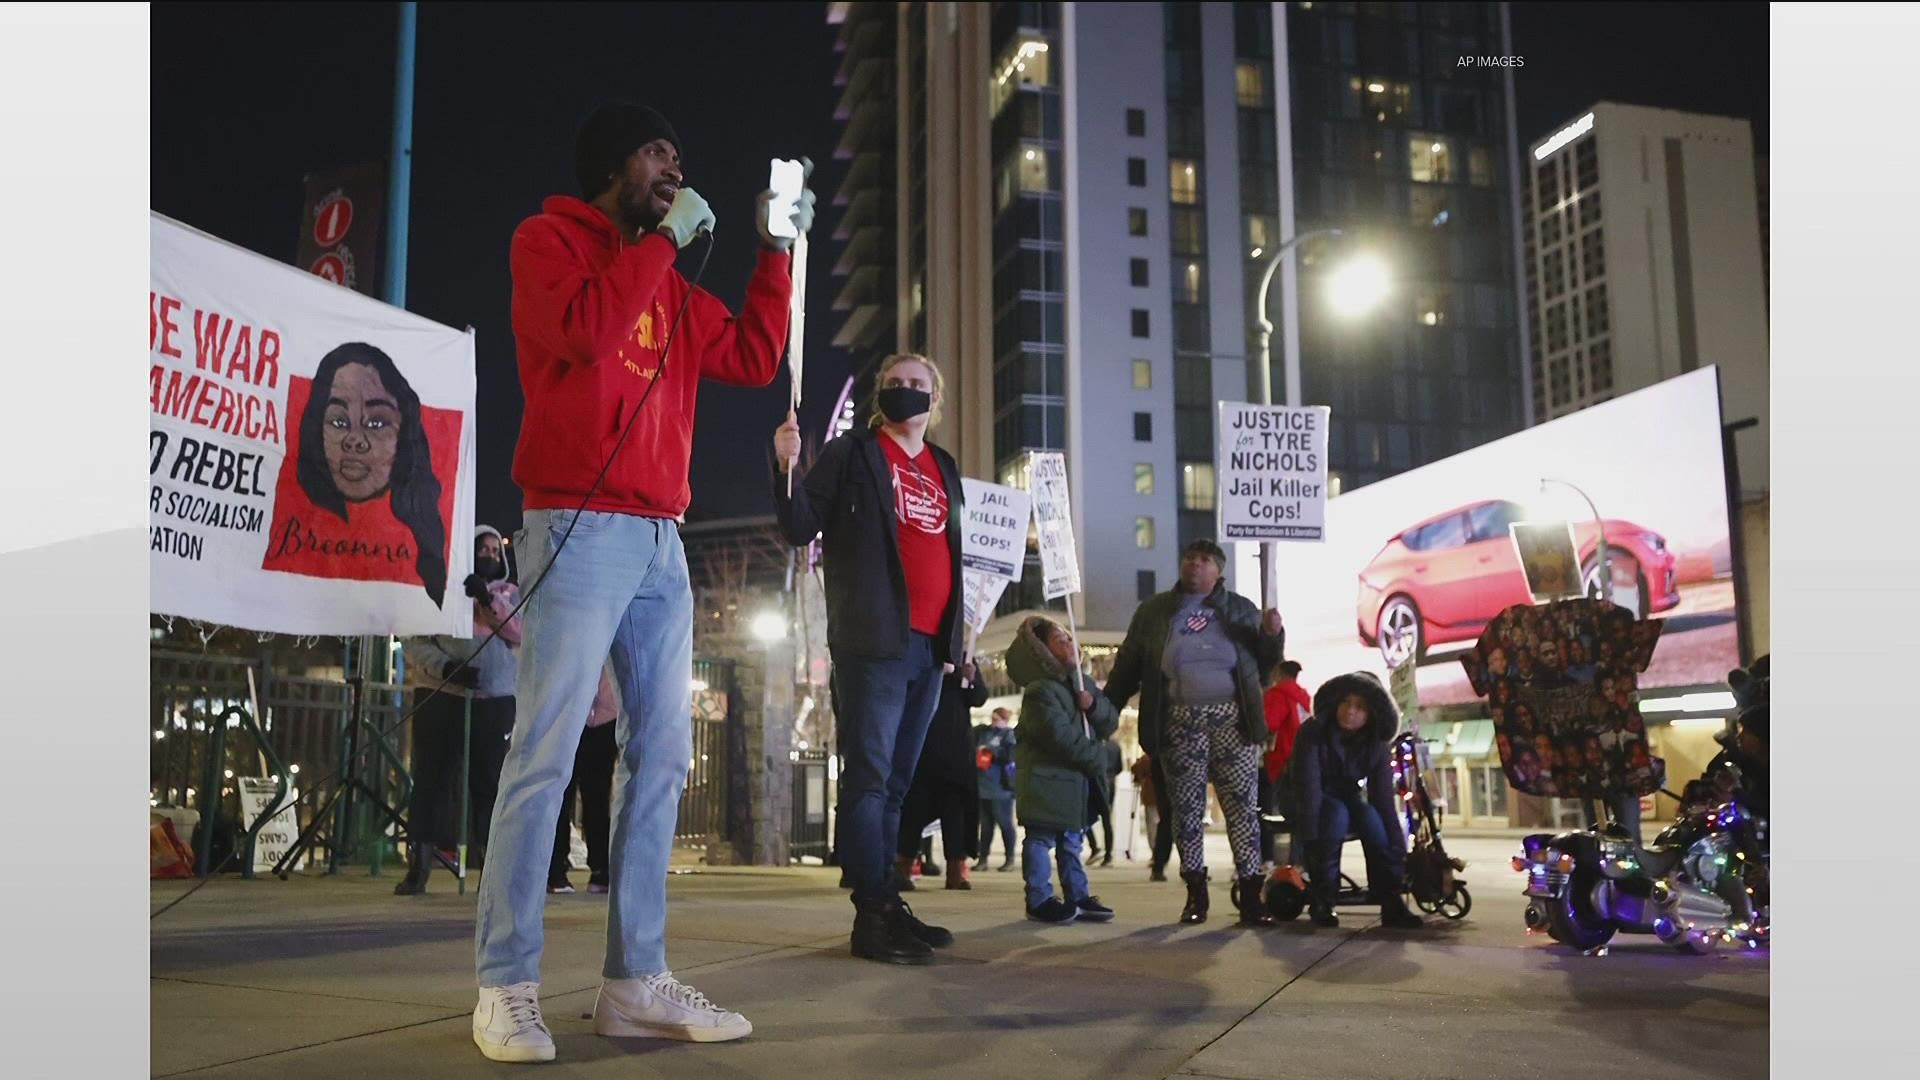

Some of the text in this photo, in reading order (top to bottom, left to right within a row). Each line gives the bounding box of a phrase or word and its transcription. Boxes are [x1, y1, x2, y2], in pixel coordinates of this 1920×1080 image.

[193, 308, 281, 389] WAR
[150, 364, 279, 444] AMERICA
[1232, 411, 1315, 431] JUSTICE
[1235, 430, 1312, 452] for TYRE
[170, 437, 266, 497] REBEL
[1231, 452, 1318, 473] NICHOLS
[1229, 478, 1321, 498] Jail Killer
[981, 491, 1009, 507] JAIL
[165, 491, 264, 533] SOCIALISM
[969, 510, 1017, 530] KILLER
[1249, 500, 1301, 523] Cops!
[269, 516, 411, 562] Breonna
[970, 533, 1011, 550] COPS!
[258, 832, 289, 844] CAMS
[263, 851, 285, 863] ODY
